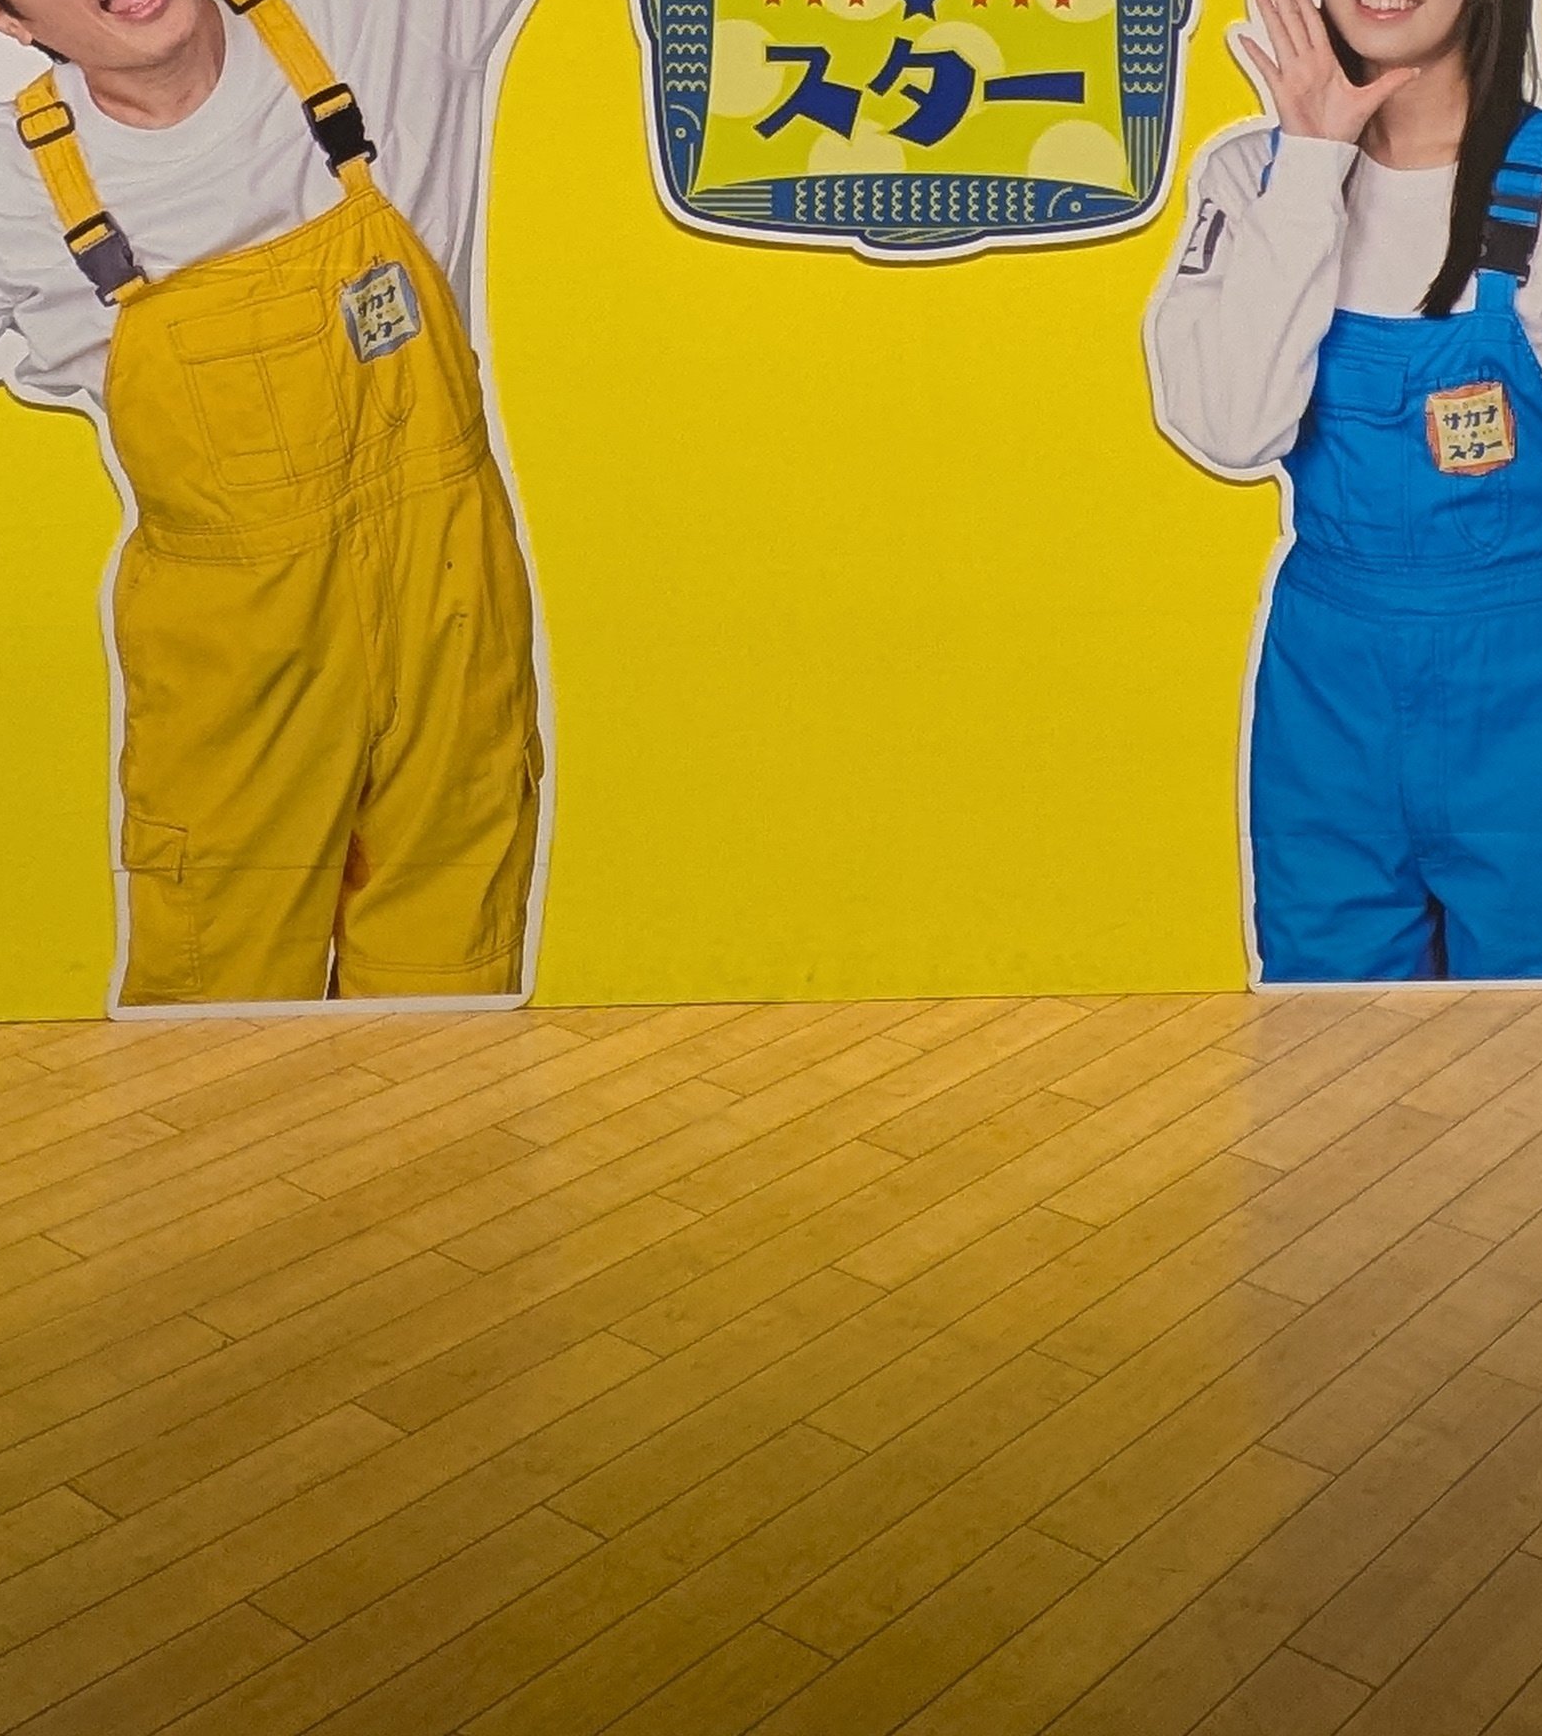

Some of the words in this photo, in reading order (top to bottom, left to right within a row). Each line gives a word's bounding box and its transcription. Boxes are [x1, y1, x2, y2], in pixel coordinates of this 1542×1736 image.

[752, 35, 1086, 148] スター
[1443, 405, 1499, 430] サカナ
[1448, 440, 1503, 460] スター
